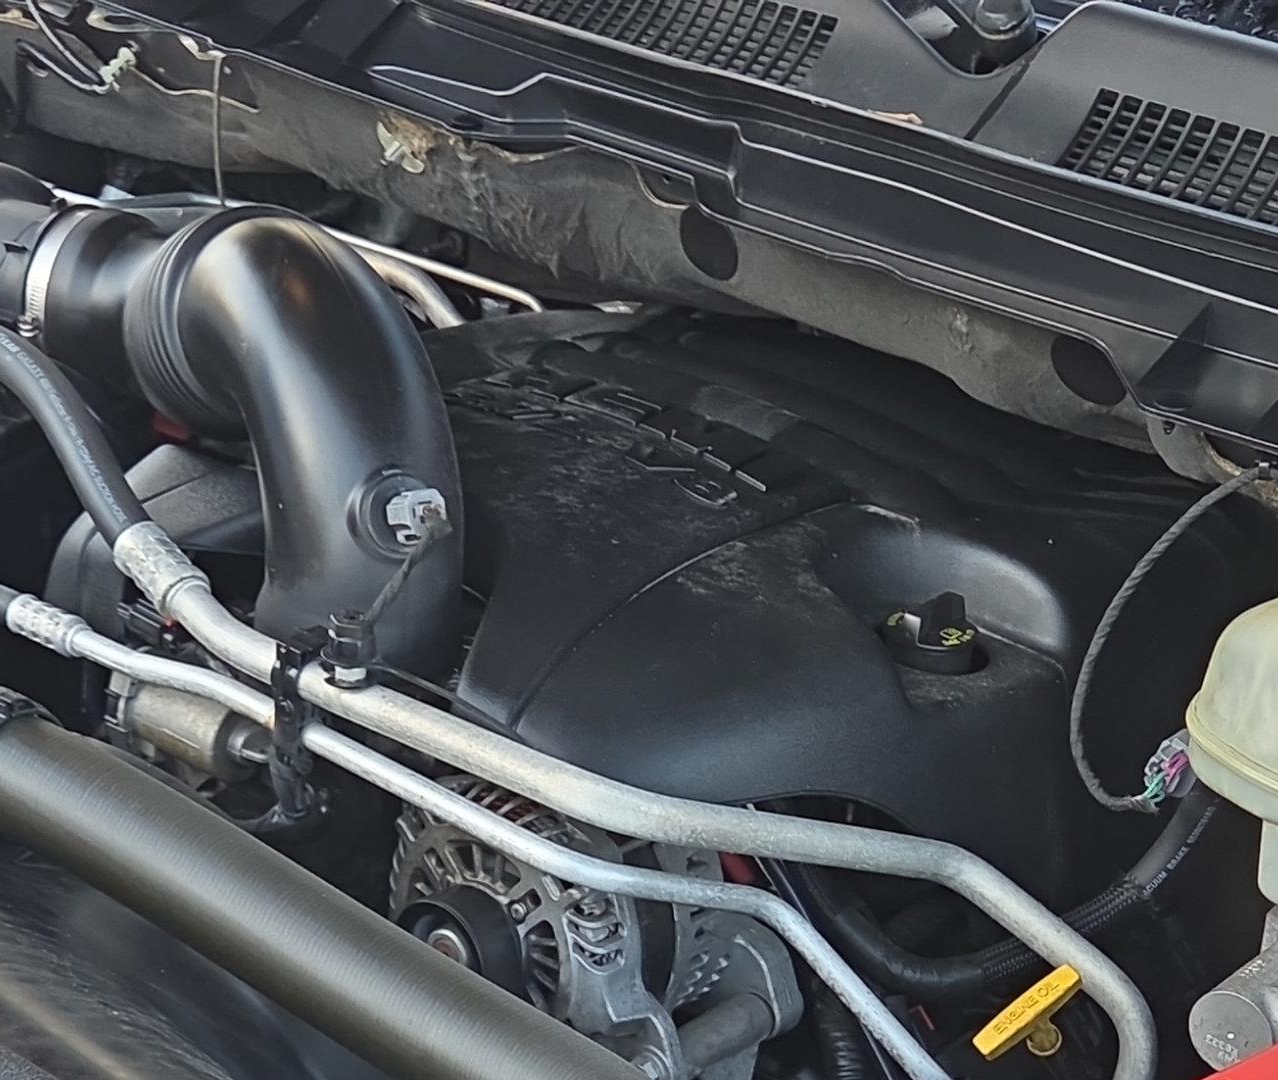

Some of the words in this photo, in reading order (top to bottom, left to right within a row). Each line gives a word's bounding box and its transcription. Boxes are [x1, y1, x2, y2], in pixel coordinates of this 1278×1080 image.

[1143, 871, 1168, 896] ACUUM
[993, 995, 1038, 1035] ENGINE
[1037, 980, 1061, 998] OIL
